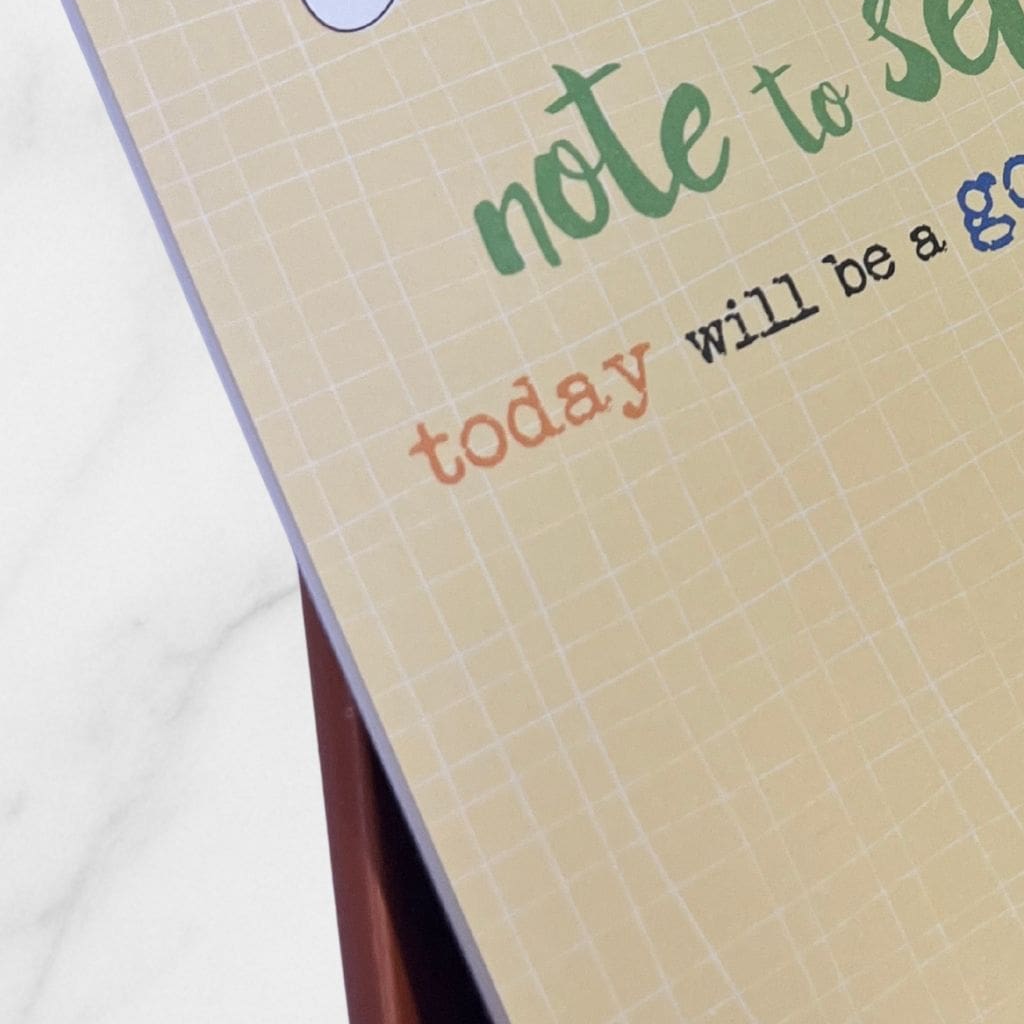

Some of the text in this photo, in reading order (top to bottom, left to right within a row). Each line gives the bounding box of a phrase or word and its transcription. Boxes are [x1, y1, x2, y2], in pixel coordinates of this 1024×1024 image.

[473, 62, 731, 276] note
[750, 63, 854, 154] to
[408, 341, 651, 486] today
[684, 272, 820, 364] will
[821, 242, 896, 298] be
[909, 223, 949, 262] a
